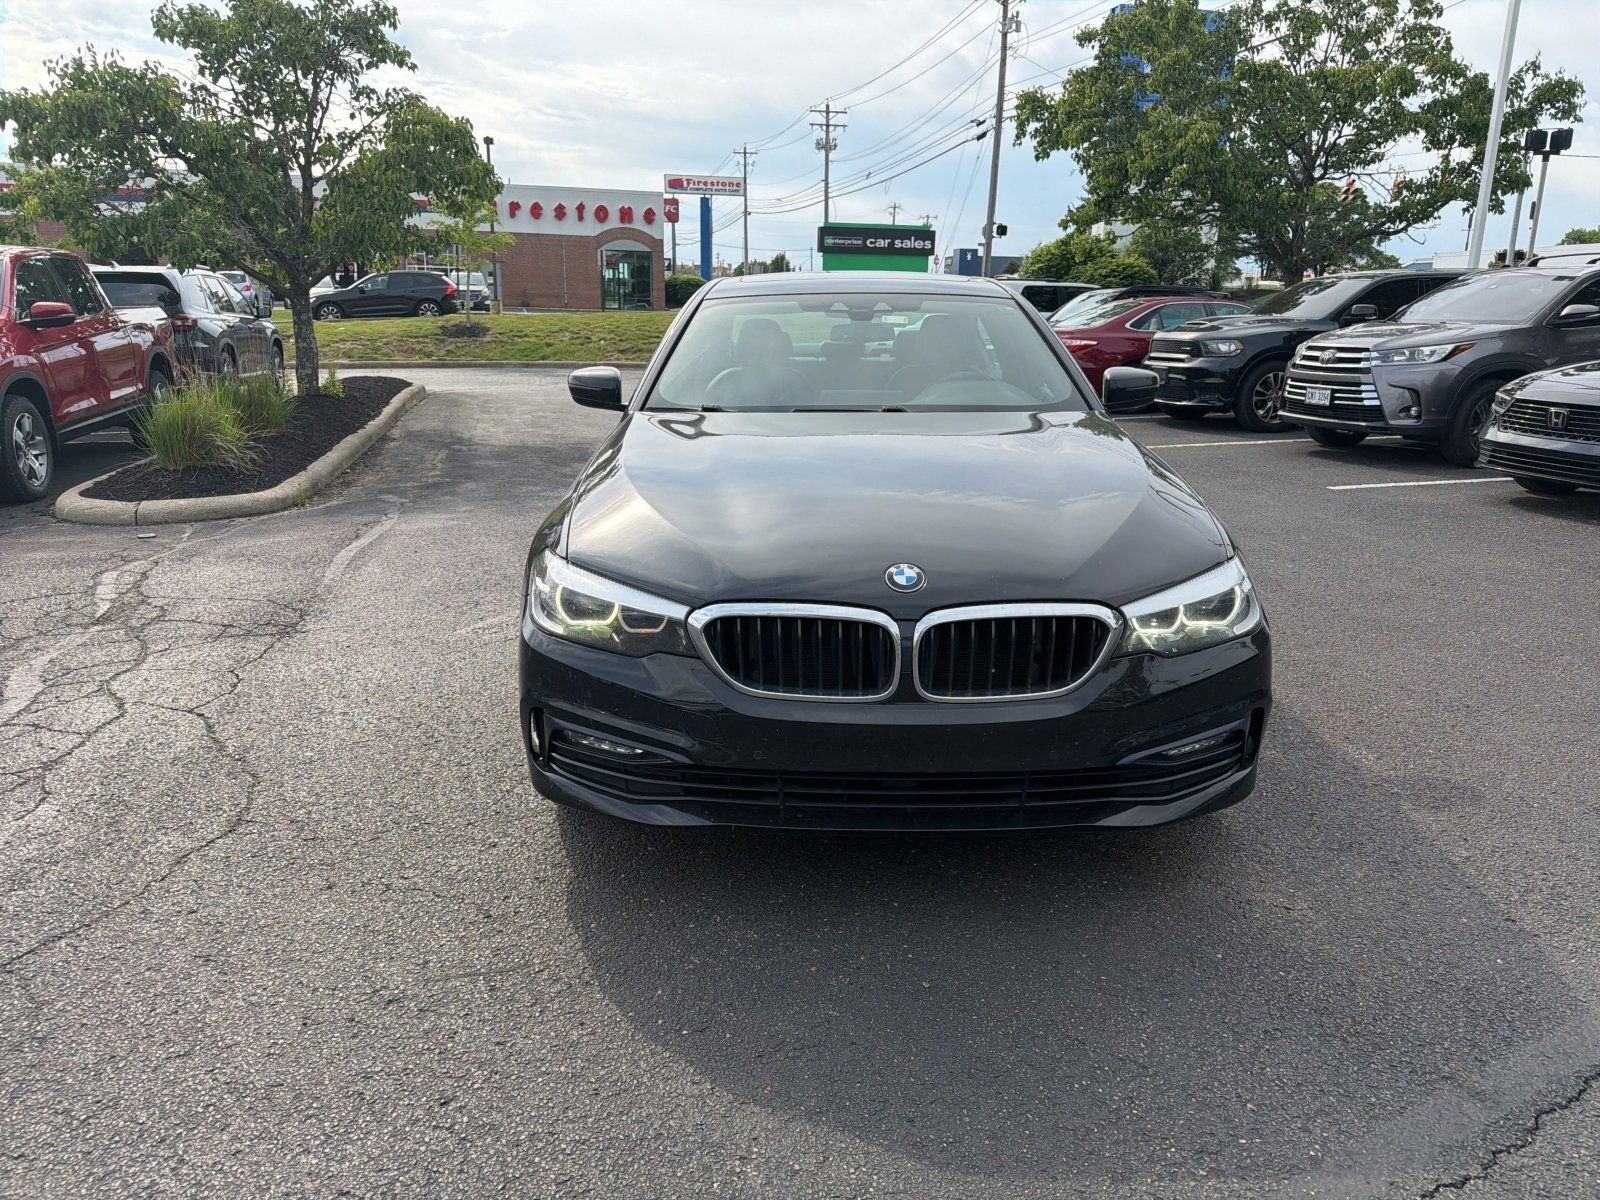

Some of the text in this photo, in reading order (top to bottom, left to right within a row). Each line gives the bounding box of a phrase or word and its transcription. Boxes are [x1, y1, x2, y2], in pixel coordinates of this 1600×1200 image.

[684, 178, 742, 188] Firestone
[664, 205, 678, 213] FC
[826, 236, 932, 249] enterprise car sales
